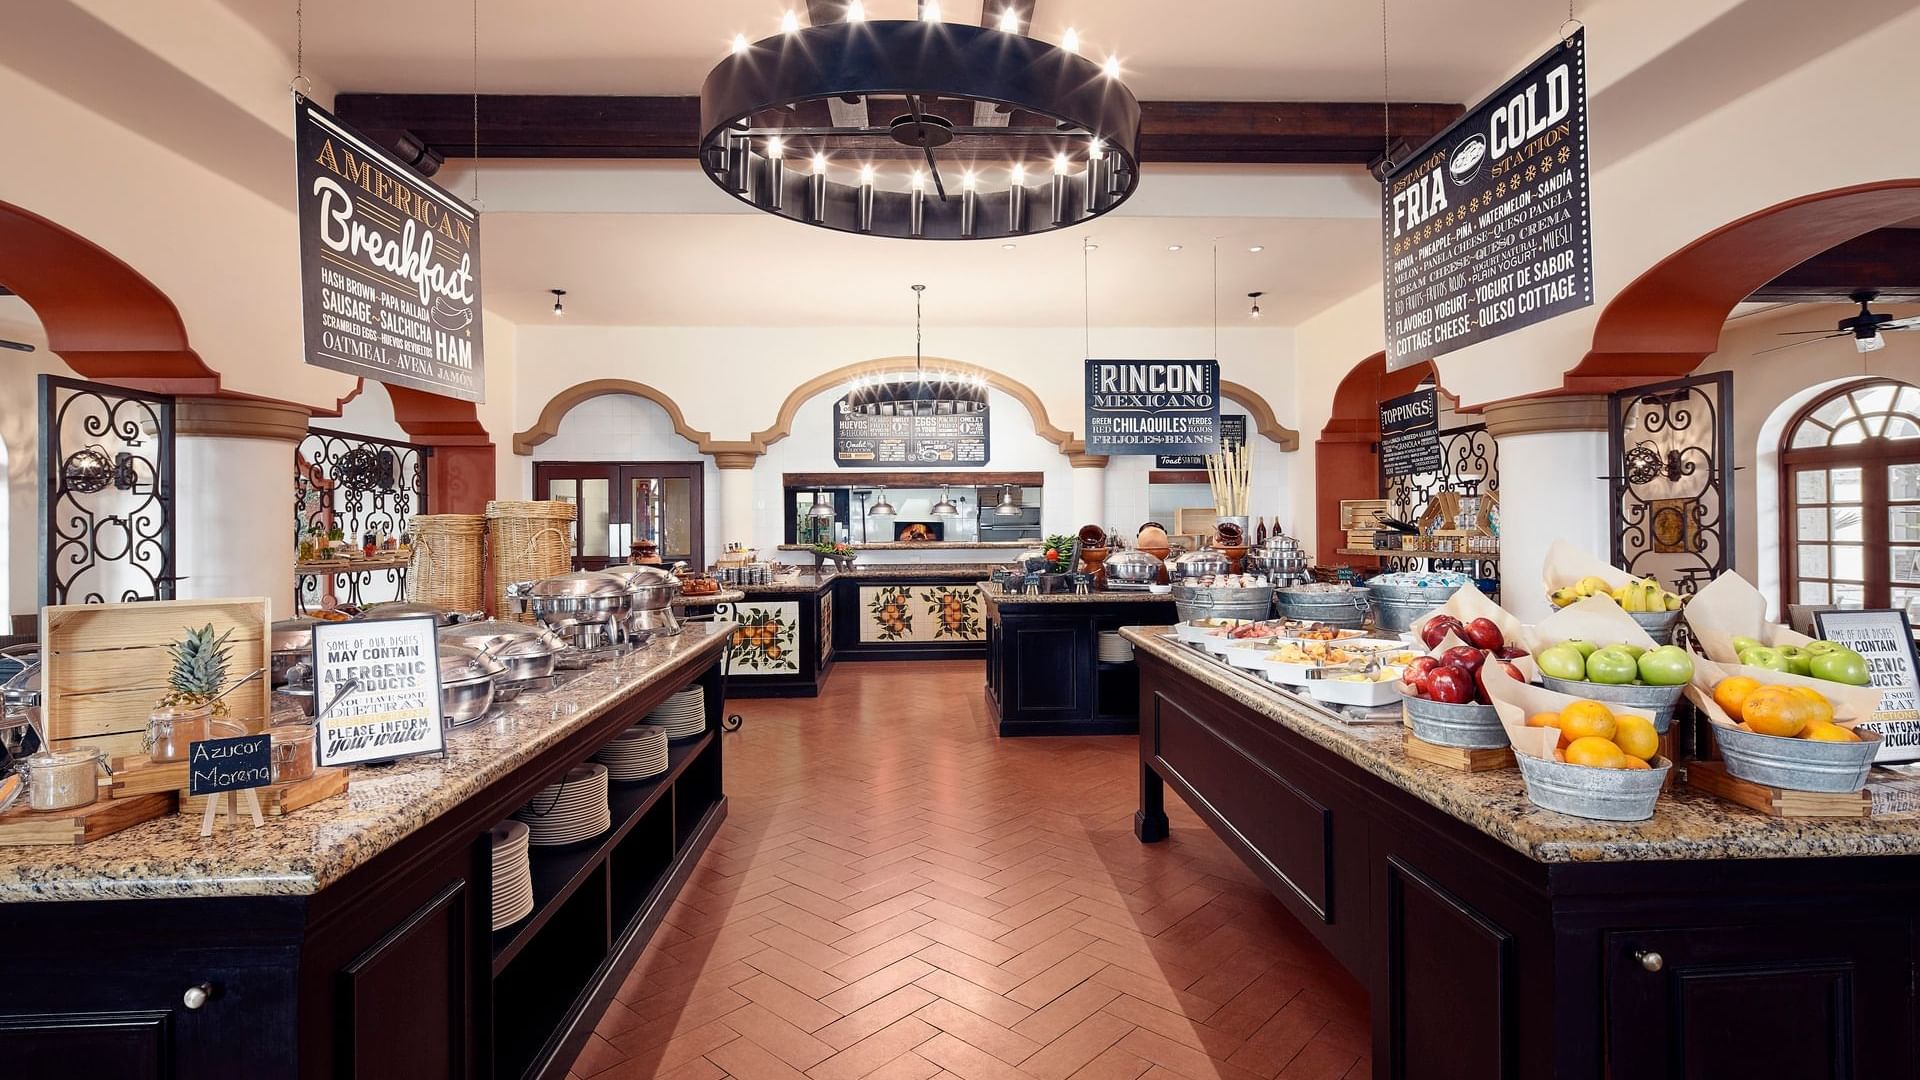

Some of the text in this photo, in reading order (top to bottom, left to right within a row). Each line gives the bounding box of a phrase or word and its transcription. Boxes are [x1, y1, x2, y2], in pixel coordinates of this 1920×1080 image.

[1490, 64, 1569, 159] COLD
[1492, 120, 1571, 178] STATION
[1393, 149, 1446, 193] ESTACIÓN
[316, 139, 471, 248] AMERICAN
[1393, 167, 1447, 238] FRIA
[1394, 168, 1573, 273] PAPAYA PINEAPPLE PIÑA WATERMELON SANDÍA
[314, 177, 473, 306] Breakfast
[1394, 189, 1573, 285] MELON PANELA CHEESE QUESO PANELA
[1542, 223, 1572, 253] MUESLI
[1394, 208, 1572, 298] CREAM CHEESE QUESO CREMA
[1472, 238, 1537, 273] YOGURT NATURAL
[1472, 248, 1537, 284] PLAIN YOGURT
[322, 267, 430, 323] HASH BROWN PAPA RALLADA
[1395, 250, 1574, 336] FLAVORED YOGURT YOGURT DE SABOR
[322, 288, 432, 344] SAUSAGE SALCHICHA
[1396, 274, 1576, 356] COTTAGE CHEESE QUESO COTTAGE
[322, 314, 432, 358] SCRAMBLED EGGS HUEVOS REVUELTOS
[435, 330, 472, 369] HAM
[323, 331, 433, 376] OATMEAL AVENA
[438, 368, 472, 387] JAMÓN
[1100, 364, 1205, 393] RINCON
[1093, 394, 1212, 407] MEXICANO
[1382, 400, 1429, 424] TOPPINGS
[840, 421, 867, 429] HUEVOS
[915, 417, 936, 426] EGGS
[1092, 417, 1111, 425] GREEN
[1113, 417, 1187, 433] CHILAQUILES
[1092, 435, 1213, 444] FRIJOLES BEANS
[1161, 456, 1182, 464] Toast
[327, 634, 418, 651] SOME OF OUR DISHES
[1828, 628, 1895, 640] SOME OF OUR DISHES
[1855, 640, 1897, 652] CONTAIN
[329, 646, 419, 663] MAY CONTAIN
[1866, 658, 1906, 672] GENIC
[325, 661, 426, 683] ALERGENIC
[335, 676, 416, 695] PODUCTS
[326, 728, 431, 758] your waiter
[329, 724, 376, 740] PLEASE
[194, 766, 270, 791] Morena
